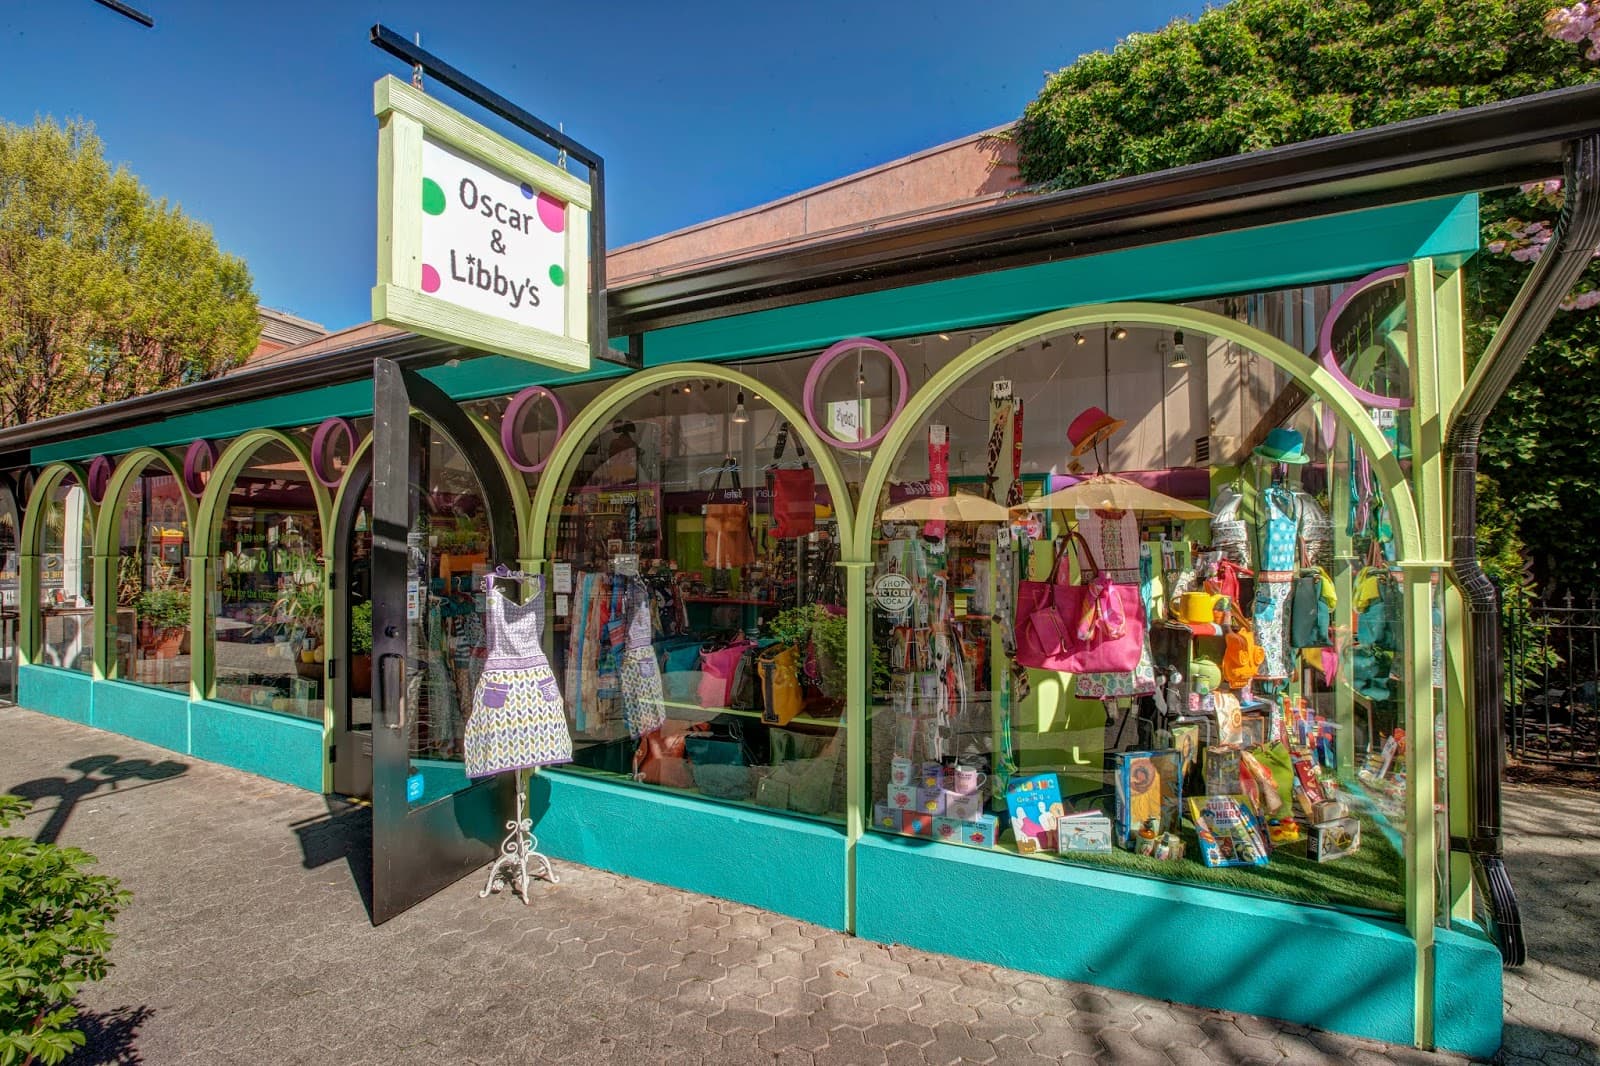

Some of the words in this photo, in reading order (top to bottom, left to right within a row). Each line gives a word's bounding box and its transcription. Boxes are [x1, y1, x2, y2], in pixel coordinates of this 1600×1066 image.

[459, 177, 534, 235] Oscar
[490, 229, 507, 255] &
[450, 249, 541, 309] Libby's
[224, 551, 257, 573] Oscar
[259, 550, 269, 573] &
[882, 580, 906, 588] SHOP
